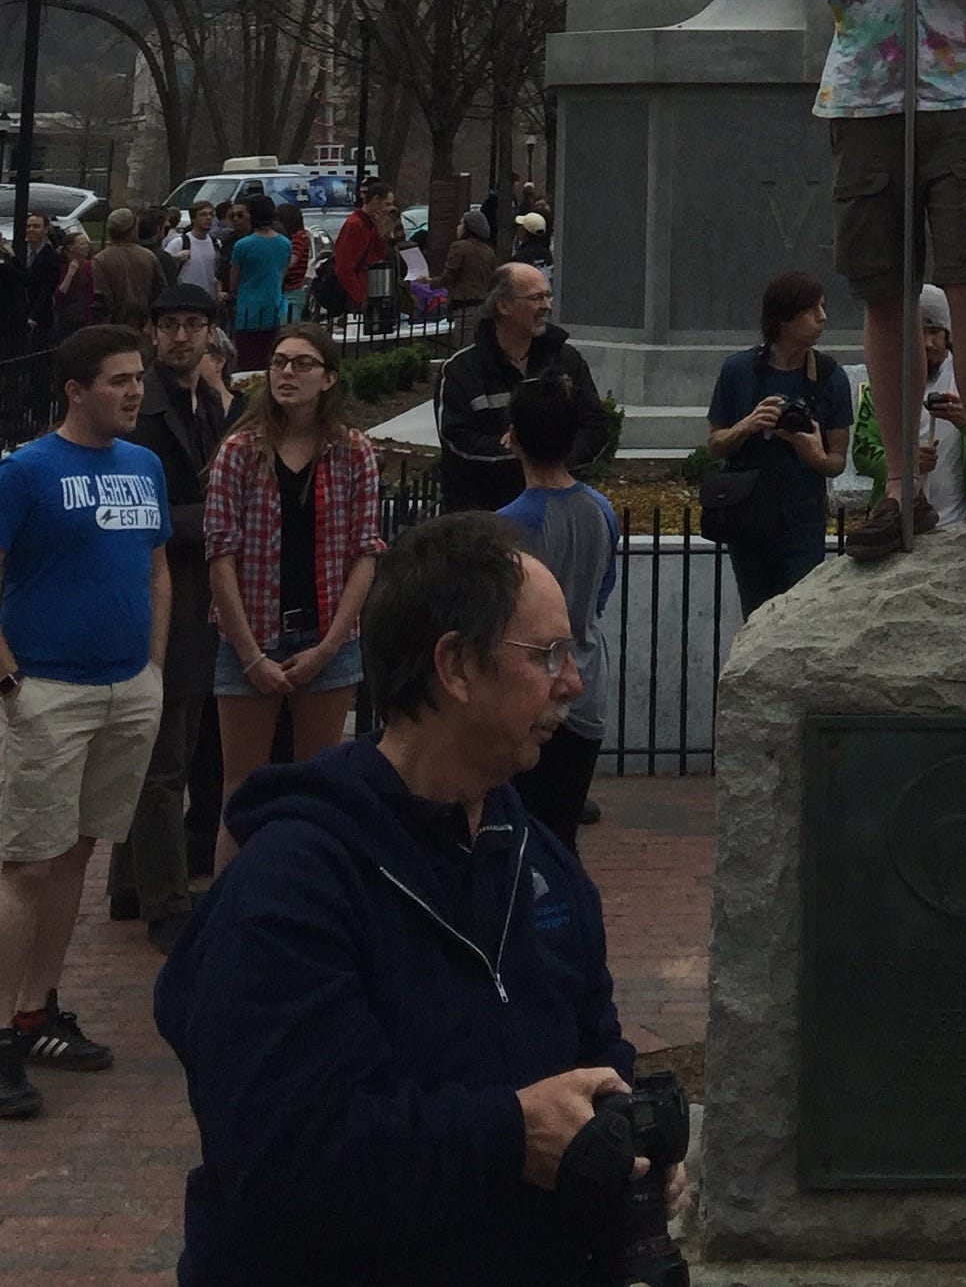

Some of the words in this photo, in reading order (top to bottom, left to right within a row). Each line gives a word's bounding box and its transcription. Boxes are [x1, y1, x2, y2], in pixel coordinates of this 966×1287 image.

[60, 476, 96, 510] UNC
[95, 474, 159, 507] ASHEVILLE
[120, 509, 138, 526] EST
